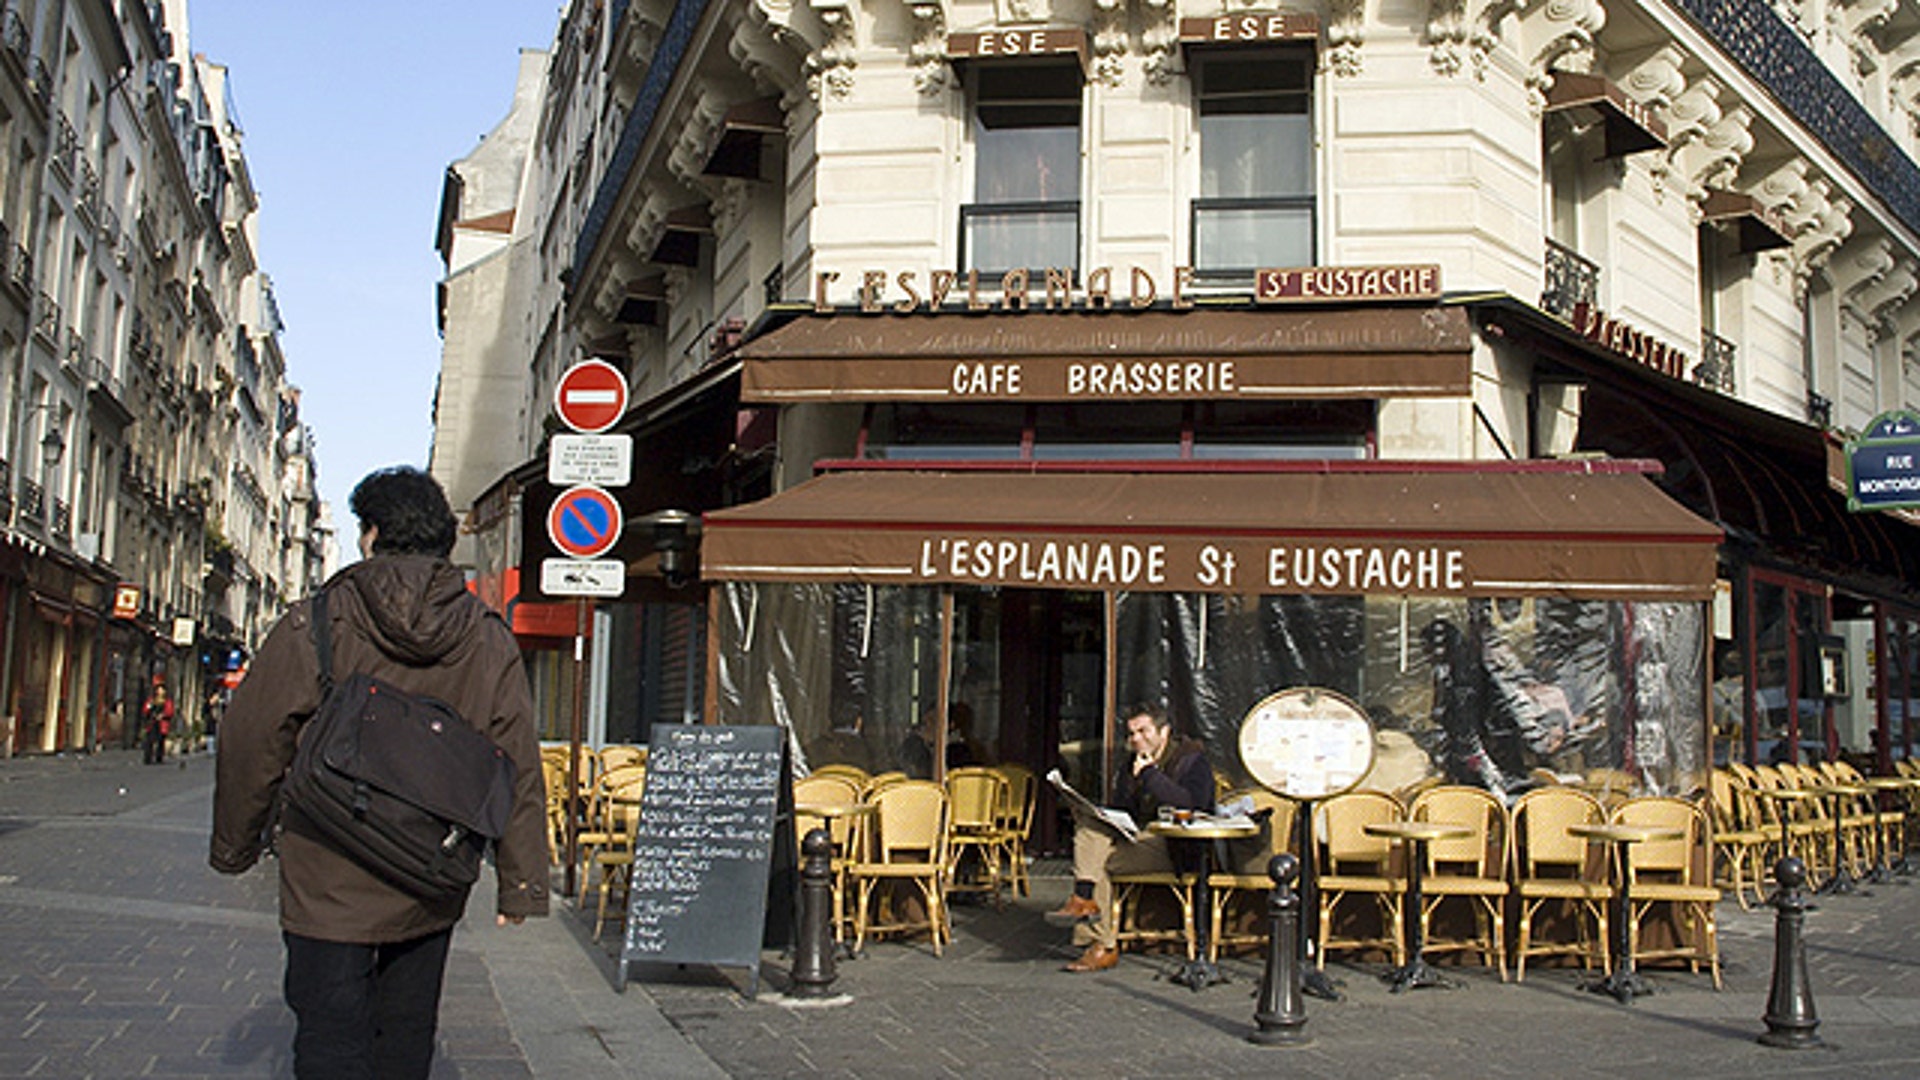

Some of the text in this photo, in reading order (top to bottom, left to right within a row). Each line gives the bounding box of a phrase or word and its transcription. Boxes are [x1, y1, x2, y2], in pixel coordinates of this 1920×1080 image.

[815, 266, 1195, 313] L'ESPLANADE
[1303, 268, 1434, 297] EUSTACHE
[952, 362, 1235, 394] CAFE BRASSERIE
[1886, 455, 1913, 469] RUE
[920, 539, 1464, 589] L'ESPLANADE St EUSTACHE
